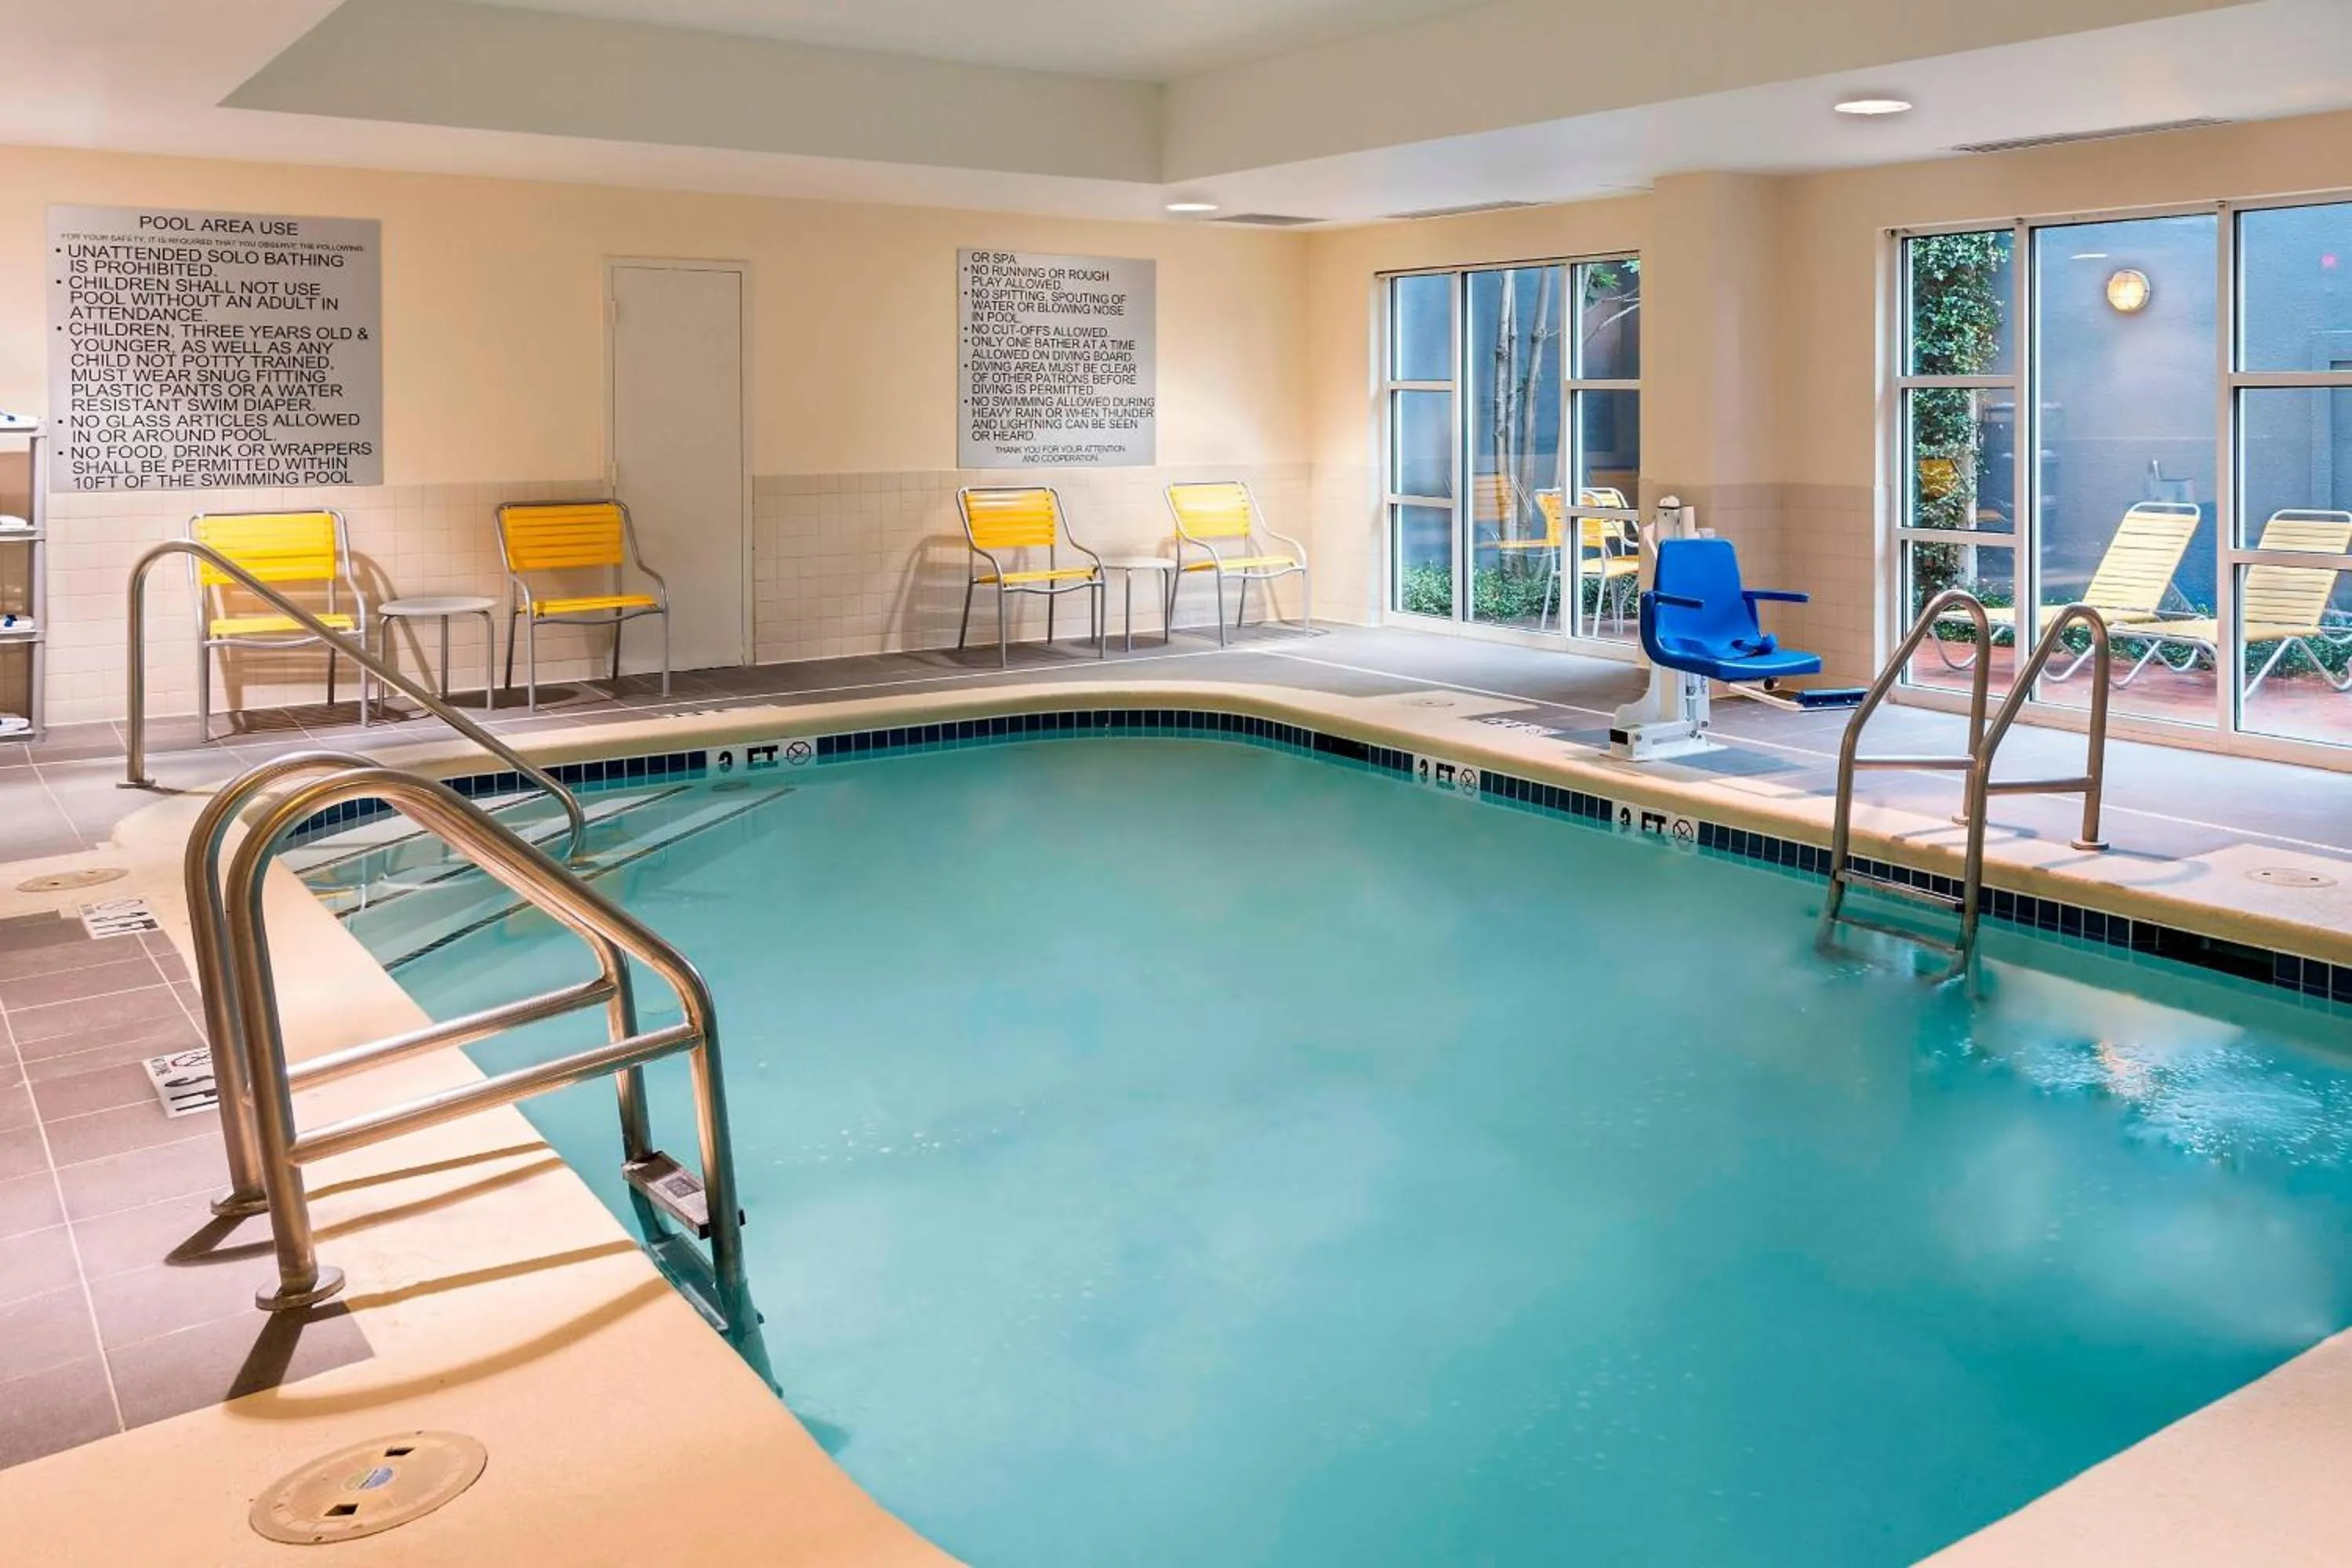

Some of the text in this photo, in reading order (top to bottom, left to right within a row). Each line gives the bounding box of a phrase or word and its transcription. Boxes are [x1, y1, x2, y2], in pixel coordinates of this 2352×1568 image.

[140, 216, 298, 235] POOL AREA USE
[68, 245, 343, 267] UNATTENDED SOLO BATHING
[972, 252, 1016, 263] OR SPA
[71, 261, 89, 273] IS
[972, 265, 1109, 281] NO RUNNING OR ROUGH
[69, 276, 321, 296] CHILDREN SHALL NOT USE
[972, 277, 1002, 287] PLAY
[71, 292, 338, 310] POOL WITHOUT AN ADULT IN
[972, 289, 988, 299] NO
[1051, 292, 1109, 303] SPOUTING
[1112, 295, 1127, 304] OF
[972, 301, 1123, 315] WATER OR BLOWING NOSE
[972, 313, 983, 322] IN
[183, 325, 244, 338] THREE
[251, 326, 310, 339] YEARS
[316, 327, 351, 339] OLD
[358, 328, 368, 339] &
[972, 325, 989, 334] NO
[993, 326, 1051, 336] CUT-OFFS
[182, 341, 205, 352] AS
[214, 341, 263, 353] WELL
[270, 343, 292, 353] AS
[298, 343, 332, 354] ANY
[971, 336, 1135, 350] ONLY ONE BATHER AT A TIME
[71, 355, 129, 367] CHILD
[136, 355, 176, 367] NOT
[183, 356, 245, 367] POTTY
[972, 350, 1029, 359] ALLOWED
[1033, 350, 1050, 360] ON
[1053, 350, 1090, 361] DIVING
[972, 361, 1136, 373] DIVING AREA MUST BE CLEAR
[71, 370, 325, 382] MUST WEAR SNUG FITTING
[972, 373, 1136, 384] OF OTHER PATRONS BEFORE
[71, 385, 343, 397] PLASTIC PANTS OR A WATER
[972, 384, 1012, 394] DIVING
[1016, 385, 1026, 394] IS
[71, 399, 181, 412] RESISTANT
[188, 399, 238, 412] SWIM
[972, 397, 1154, 407] NO SWIMMING ALLOWED DURING
[972, 408, 1154, 418] HEAVY RAIN OR WHEN THUNDER
[71, 414, 360, 428] NO GLASS ARTICLES ALLOWED
[972, 419, 1138, 429] AND LIGHTNING CAN BE SEEN
[72, 431, 90, 442] IN
[98, 430, 127, 442] OR
[133, 430, 215, 441] AROUND
[972, 431, 989, 441] OR
[71, 447, 100, 459] NO
[174, 445, 231, 457] DRINK
[238, 445, 264, 456] OR
[270, 443, 372, 456] WRAPPERS
[73, 458, 347, 474] SHALL BE PERMITTED WITHIN
[75, 472, 353, 489] 10FT OF THE SWIMMING POOL
